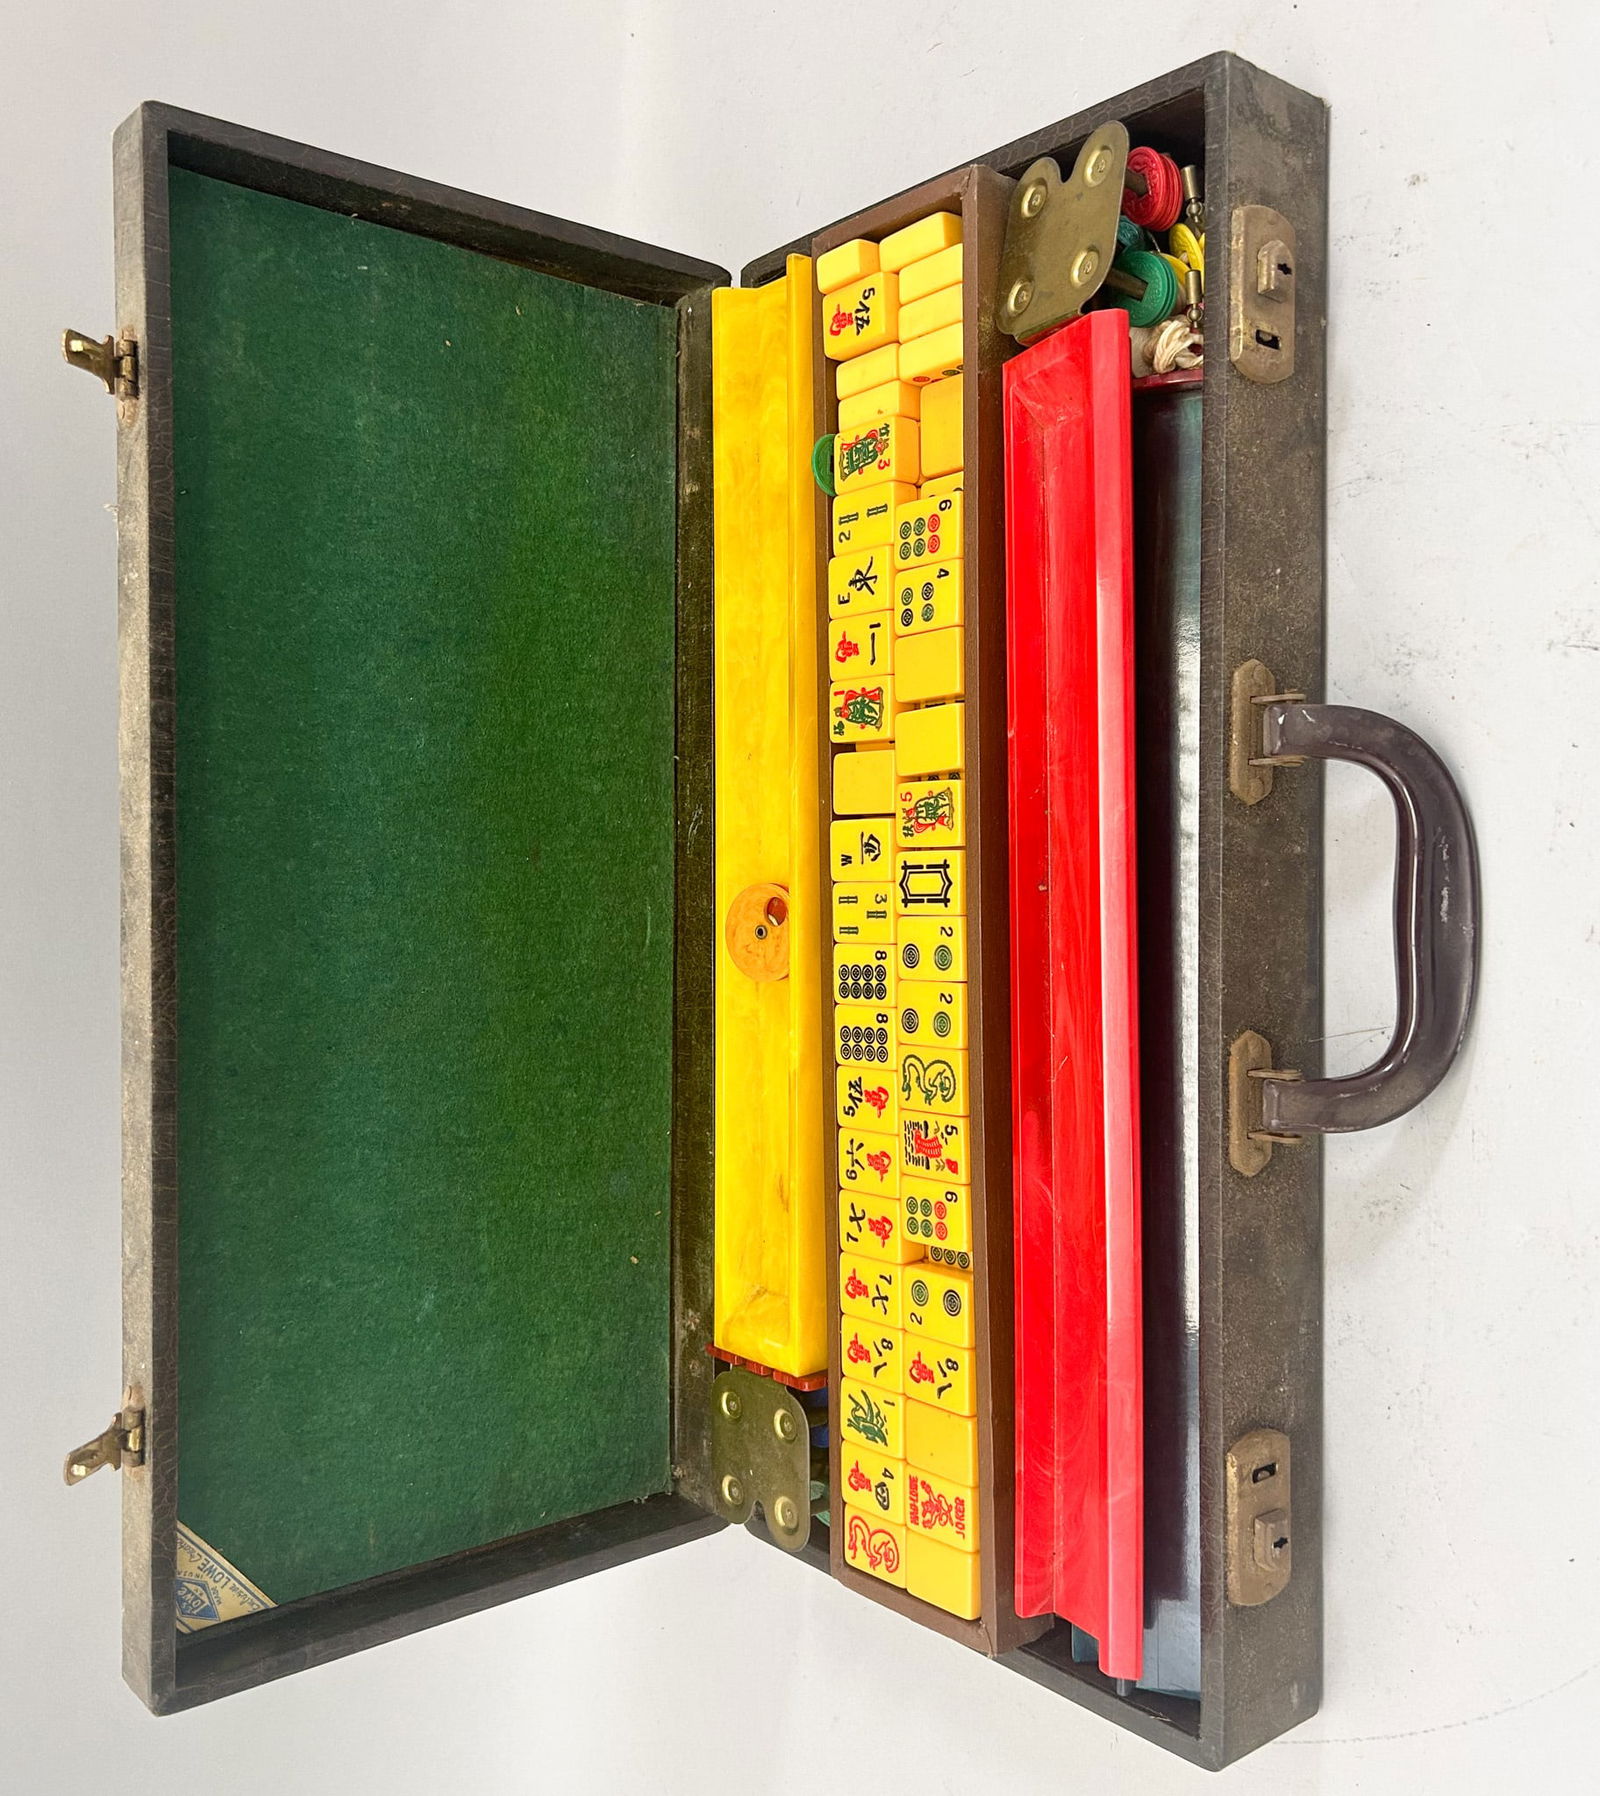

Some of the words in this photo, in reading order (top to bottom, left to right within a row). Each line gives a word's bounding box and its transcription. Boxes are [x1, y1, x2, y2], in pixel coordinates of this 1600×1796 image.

[862, 287, 875, 300] 5
[878, 458, 890, 470] 3
[939, 499, 952, 511] 6
[838, 530, 851, 543] 2
[937, 568, 950, 579] 4
[838, 592, 850, 605] E
[900, 791, 913, 802] 5
[841, 854, 853, 866] W
[874, 893, 887, 904] 3
[940, 926, 953, 937] 2
[875, 950, 887, 961] 8
[939, 993, 953, 1004] 2
[876, 1013, 888, 1024] 8
[843, 1105, 856, 1117] 5
[944, 1124, 958, 1136] 5
[846, 1169, 858, 1180] 6
[945, 1191, 958, 1203] 6
[846, 1231, 859, 1243] 7
[879, 1274, 892, 1285] 7
[910, 1312, 922, 1325] 2
[881, 1338, 893, 1350] 8
[945, 1358, 959, 1372] 8
[882, 1467, 895, 1479] 4
[954, 1497, 966, 1540] JOKER
[177, 1538, 202, 1563] Creatio
[197, 1557, 231, 1589] LOWE
[178, 1586, 208, 1614] Lowe
[229, 1582, 261, 1613] Exclusive
